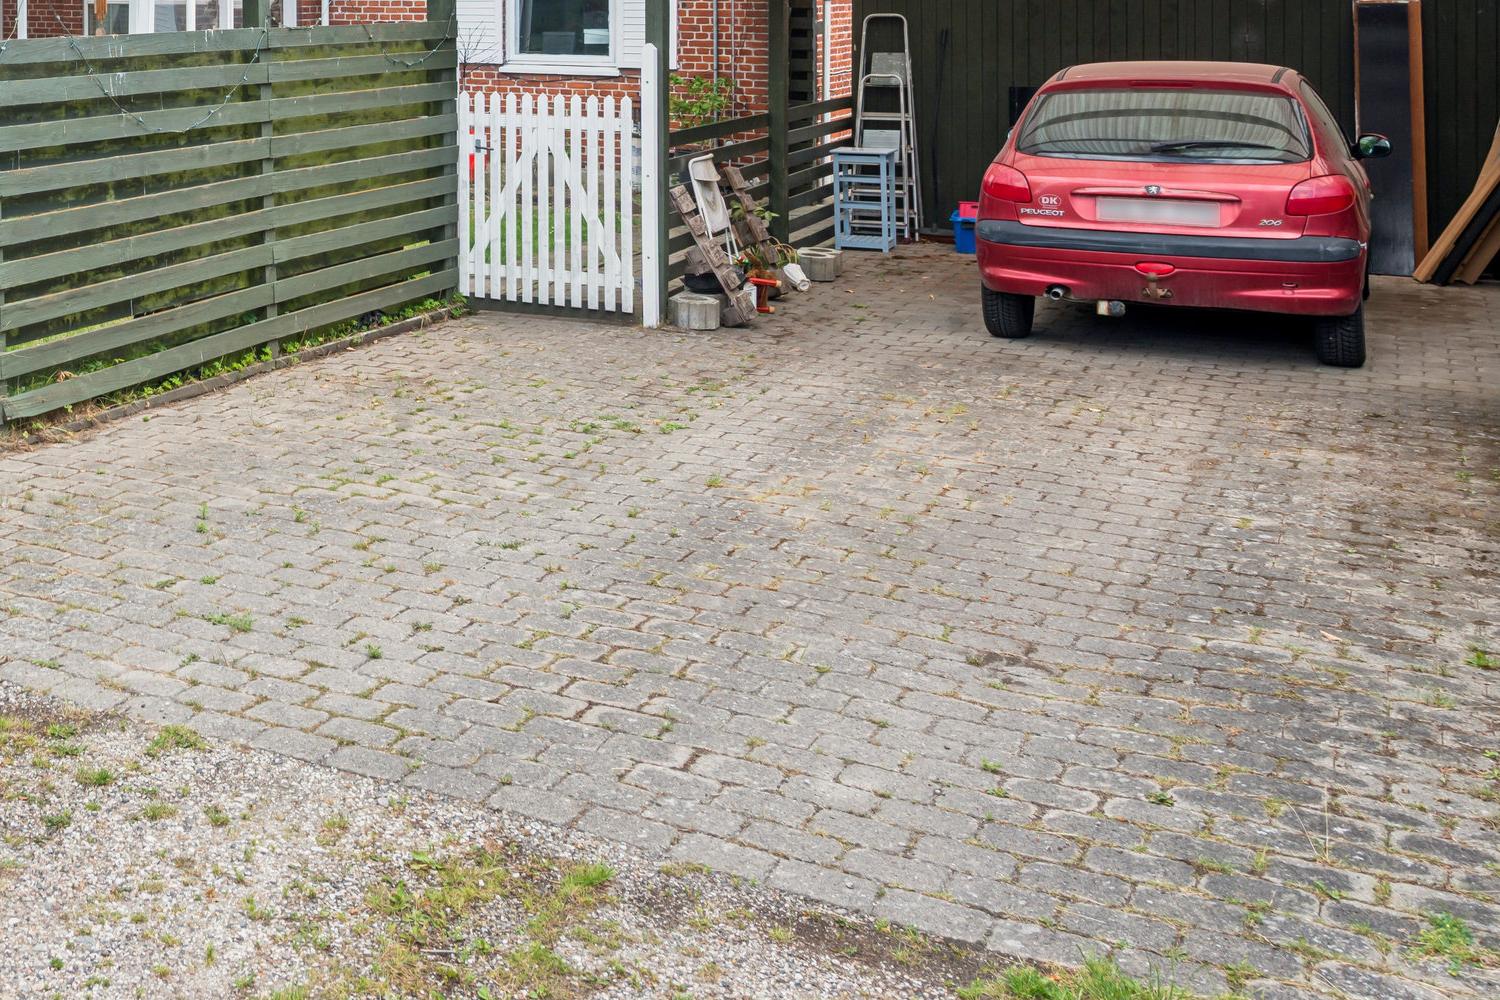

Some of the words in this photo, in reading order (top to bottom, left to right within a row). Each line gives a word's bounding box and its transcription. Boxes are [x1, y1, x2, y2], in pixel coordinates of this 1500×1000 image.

[1041, 196, 1058, 205] DK
[1020, 207, 1065, 217] PEUGEOT
[1258, 218, 1283, 226] 206
